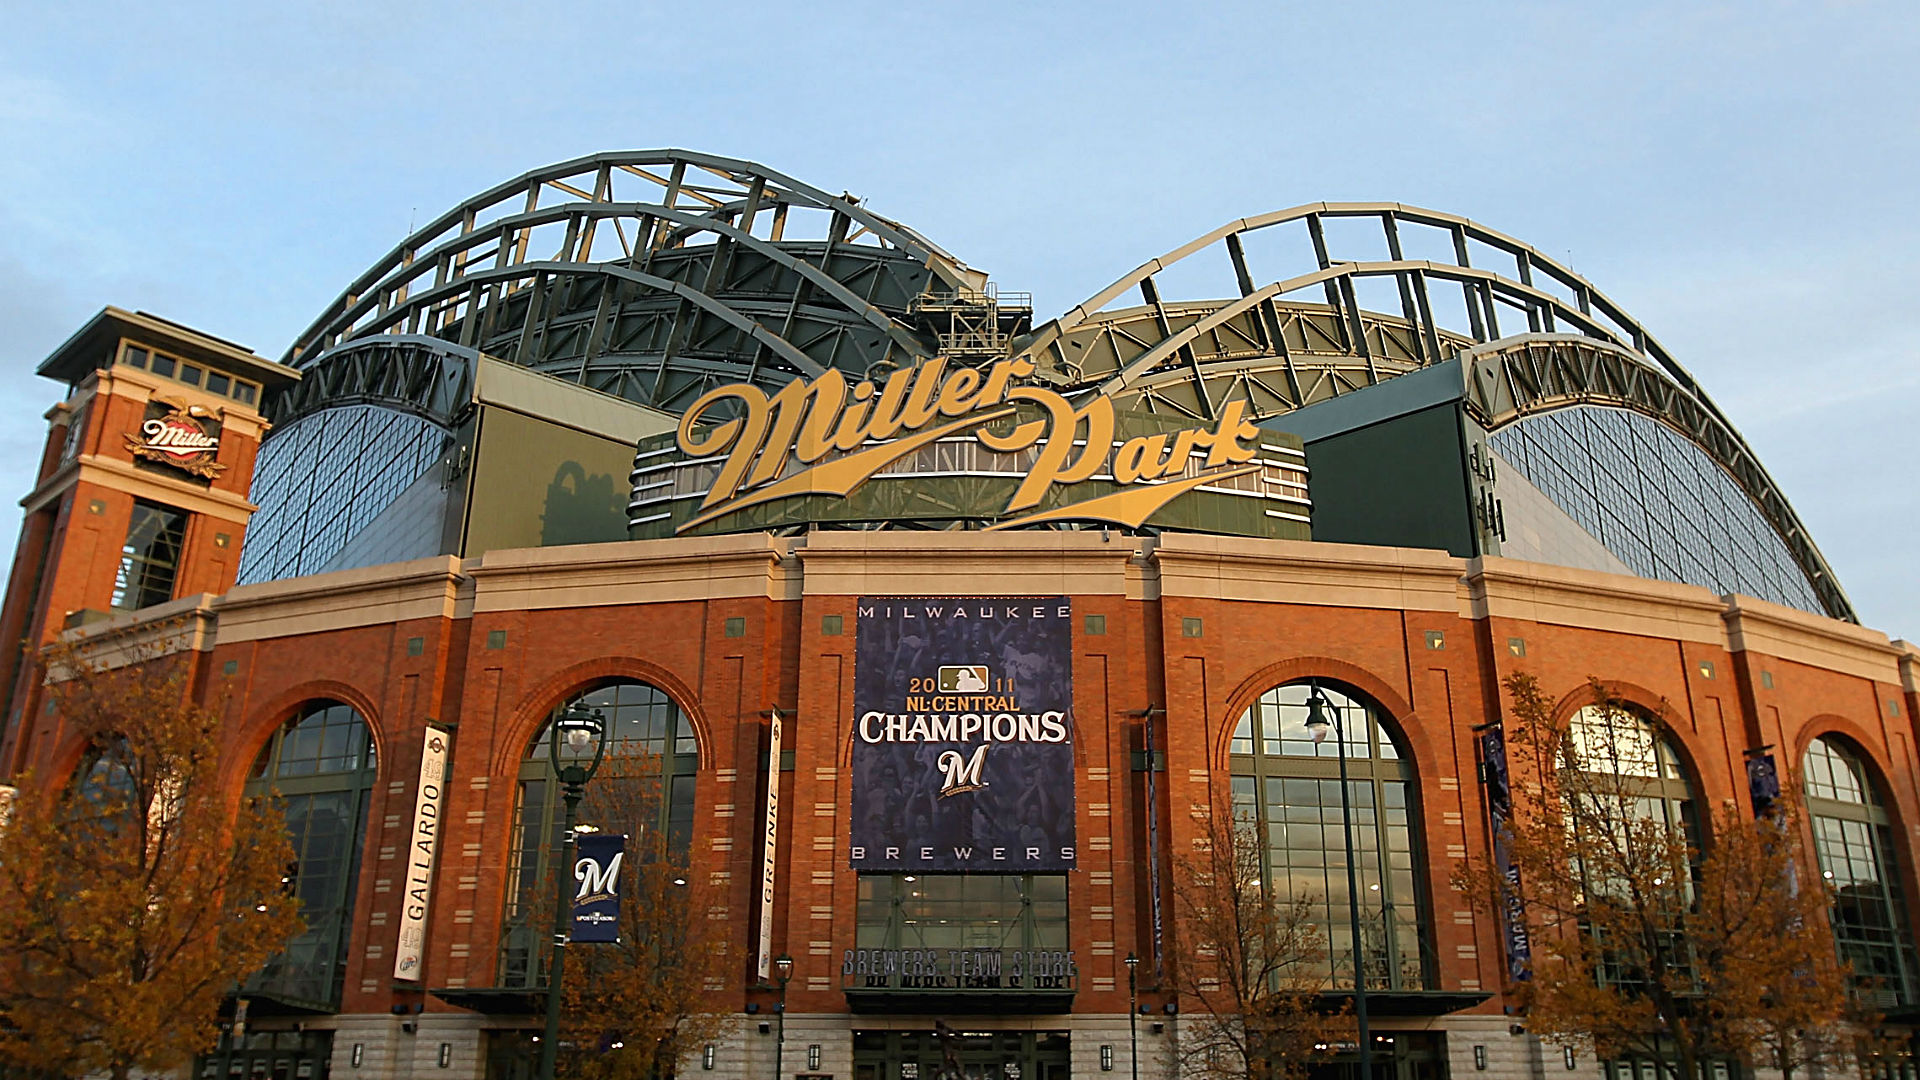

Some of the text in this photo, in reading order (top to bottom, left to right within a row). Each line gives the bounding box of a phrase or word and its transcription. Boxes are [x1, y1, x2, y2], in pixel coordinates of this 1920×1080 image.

[143, 419, 219, 455] Miller
[676, 352, 1266, 532] Miller Park
[858, 606, 1071, 618] MILWAUKEE
[910, 678, 1014, 693] 20 11
[859, 711, 1067, 743] CHAMPIONS
[937, 744, 990, 797] M
[407, 785, 439, 920] GALLARDO
[764, 784, 778, 903] GREINKE
[851, 847, 1075, 860] BREWERS
[575, 852, 624, 901] M
[843, 950, 1075, 976] BREWERS TEAM STORE
